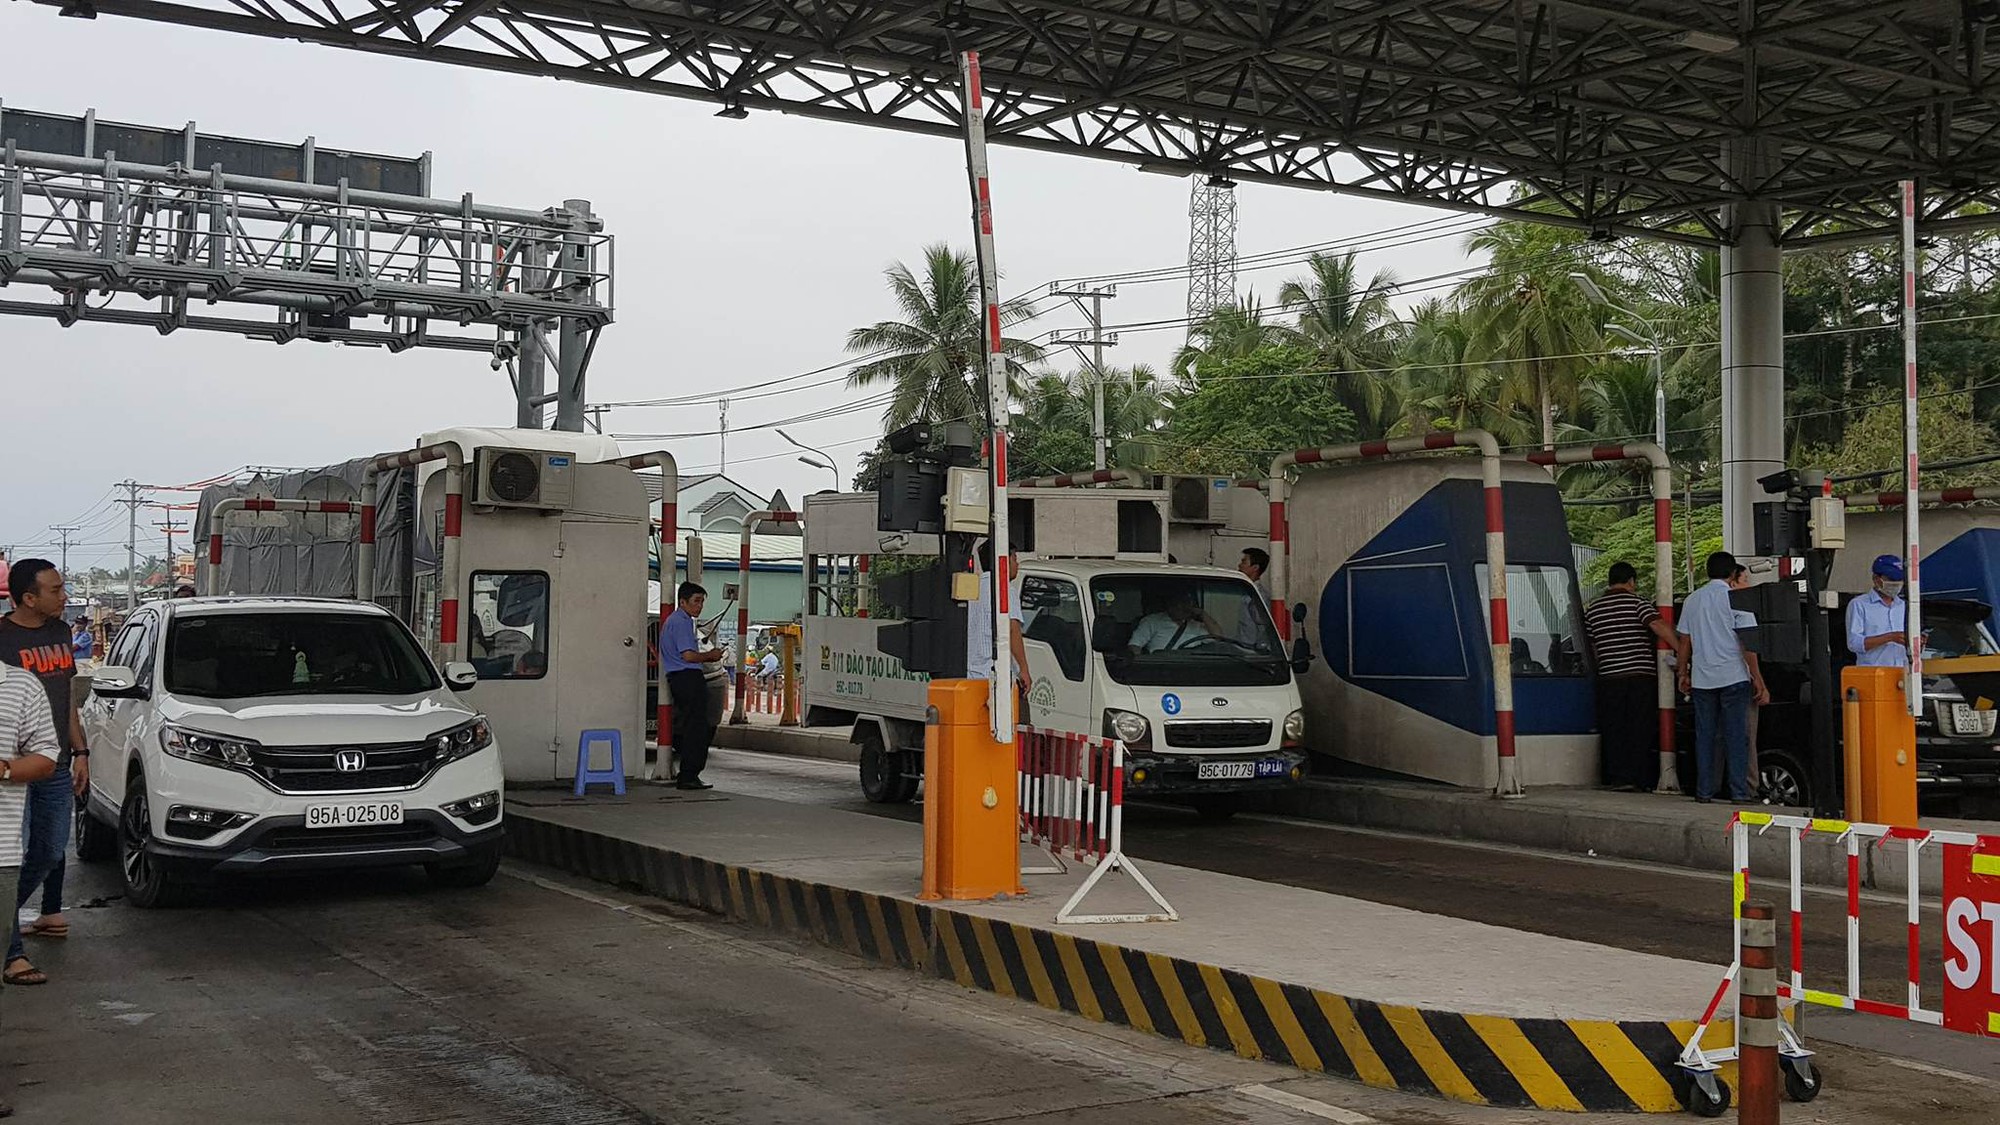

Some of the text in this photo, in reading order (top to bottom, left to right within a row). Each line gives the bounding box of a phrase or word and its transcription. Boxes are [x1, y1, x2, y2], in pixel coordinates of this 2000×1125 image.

[19, 643, 74, 673] PUMA
[866, 655, 883, 682] TẠO
[1167, 696, 1176, 712] 3
[1958, 719, 1979, 731] 3097
[310, 804, 400, 825] 95A-025.08
